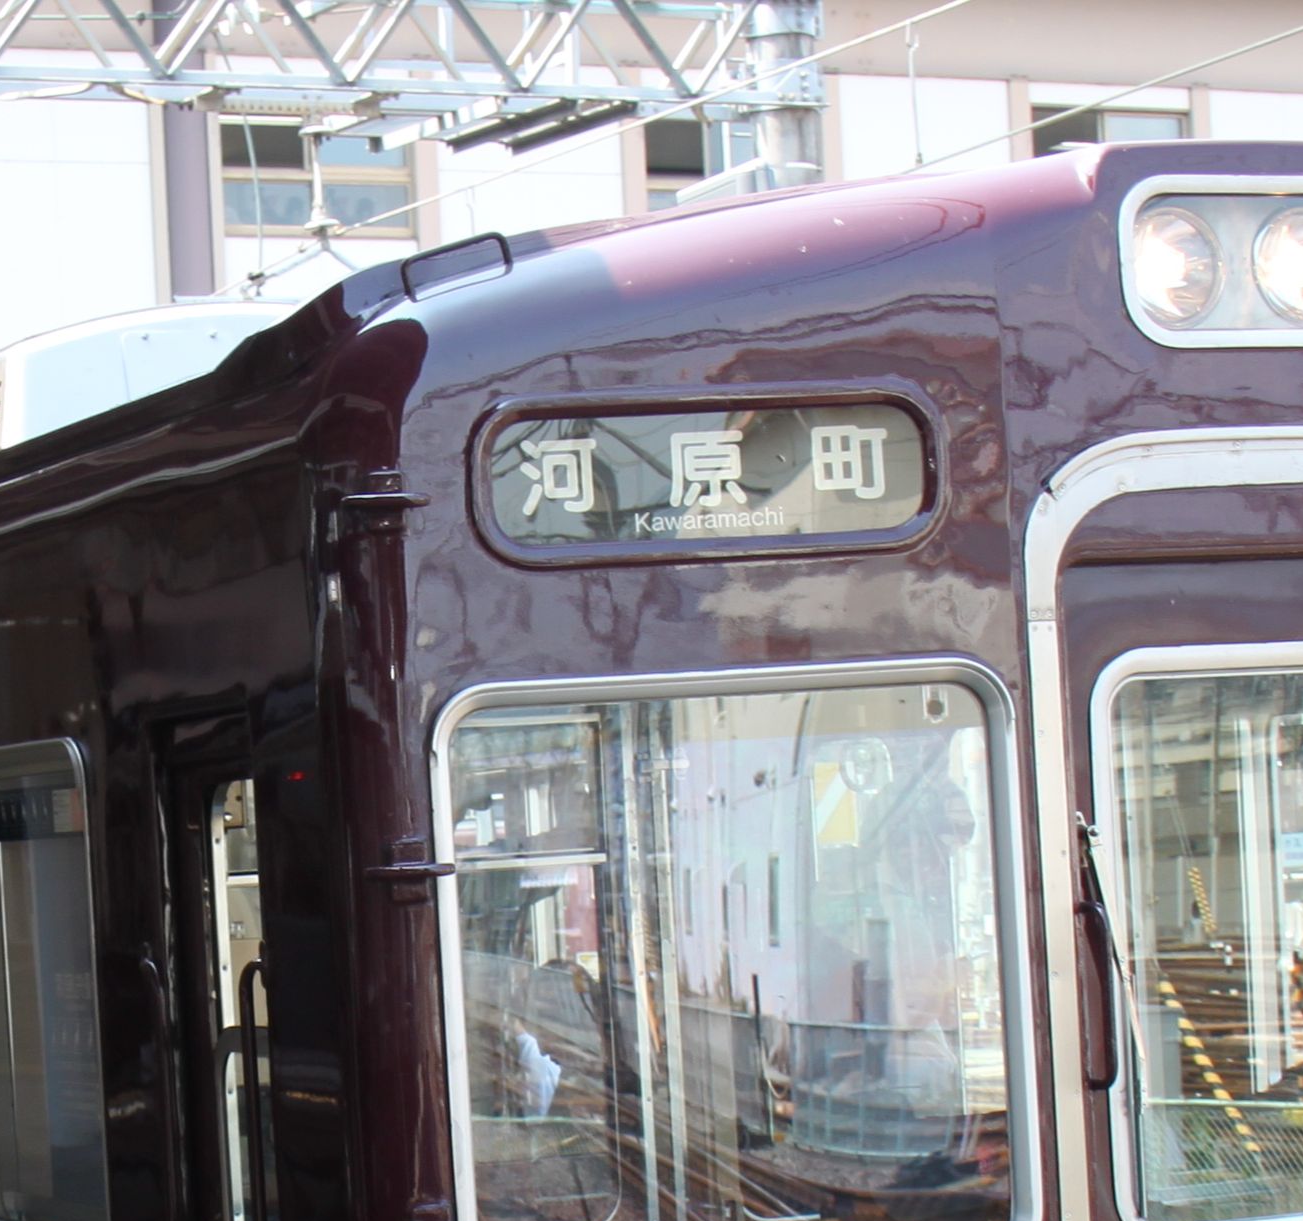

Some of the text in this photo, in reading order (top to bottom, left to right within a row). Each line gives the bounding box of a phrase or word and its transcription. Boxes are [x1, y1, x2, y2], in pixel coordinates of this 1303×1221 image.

[519, 424, 889, 517] 河原町
[634, 505, 785, 534] Kawaramachi
